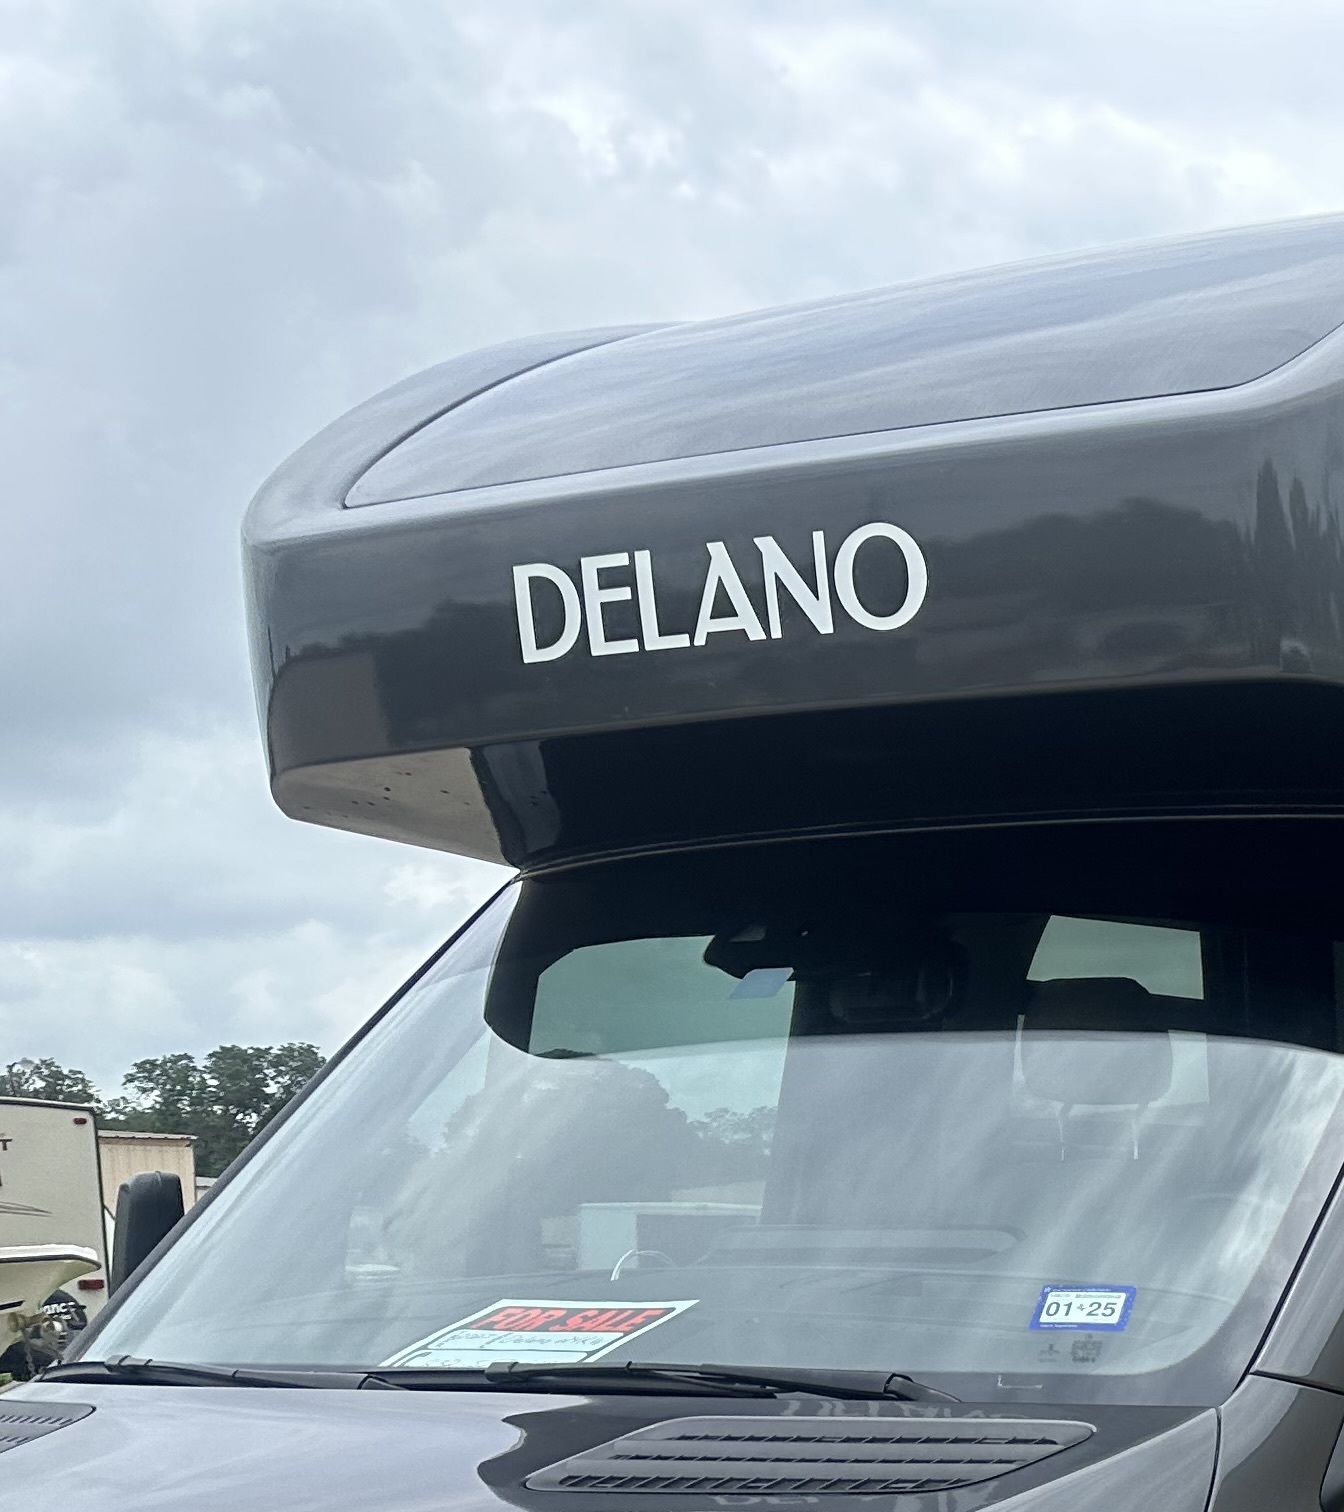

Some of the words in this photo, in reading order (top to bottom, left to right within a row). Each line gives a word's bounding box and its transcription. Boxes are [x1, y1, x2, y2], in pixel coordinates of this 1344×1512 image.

[512, 521, 929, 664] DELANO
[471, 1307, 569, 1331] FOR
[549, 1309, 664, 1333] SALE
[1045, 1301, 1073, 1317] 01
[1086, 1301, 1117, 1317] 25
